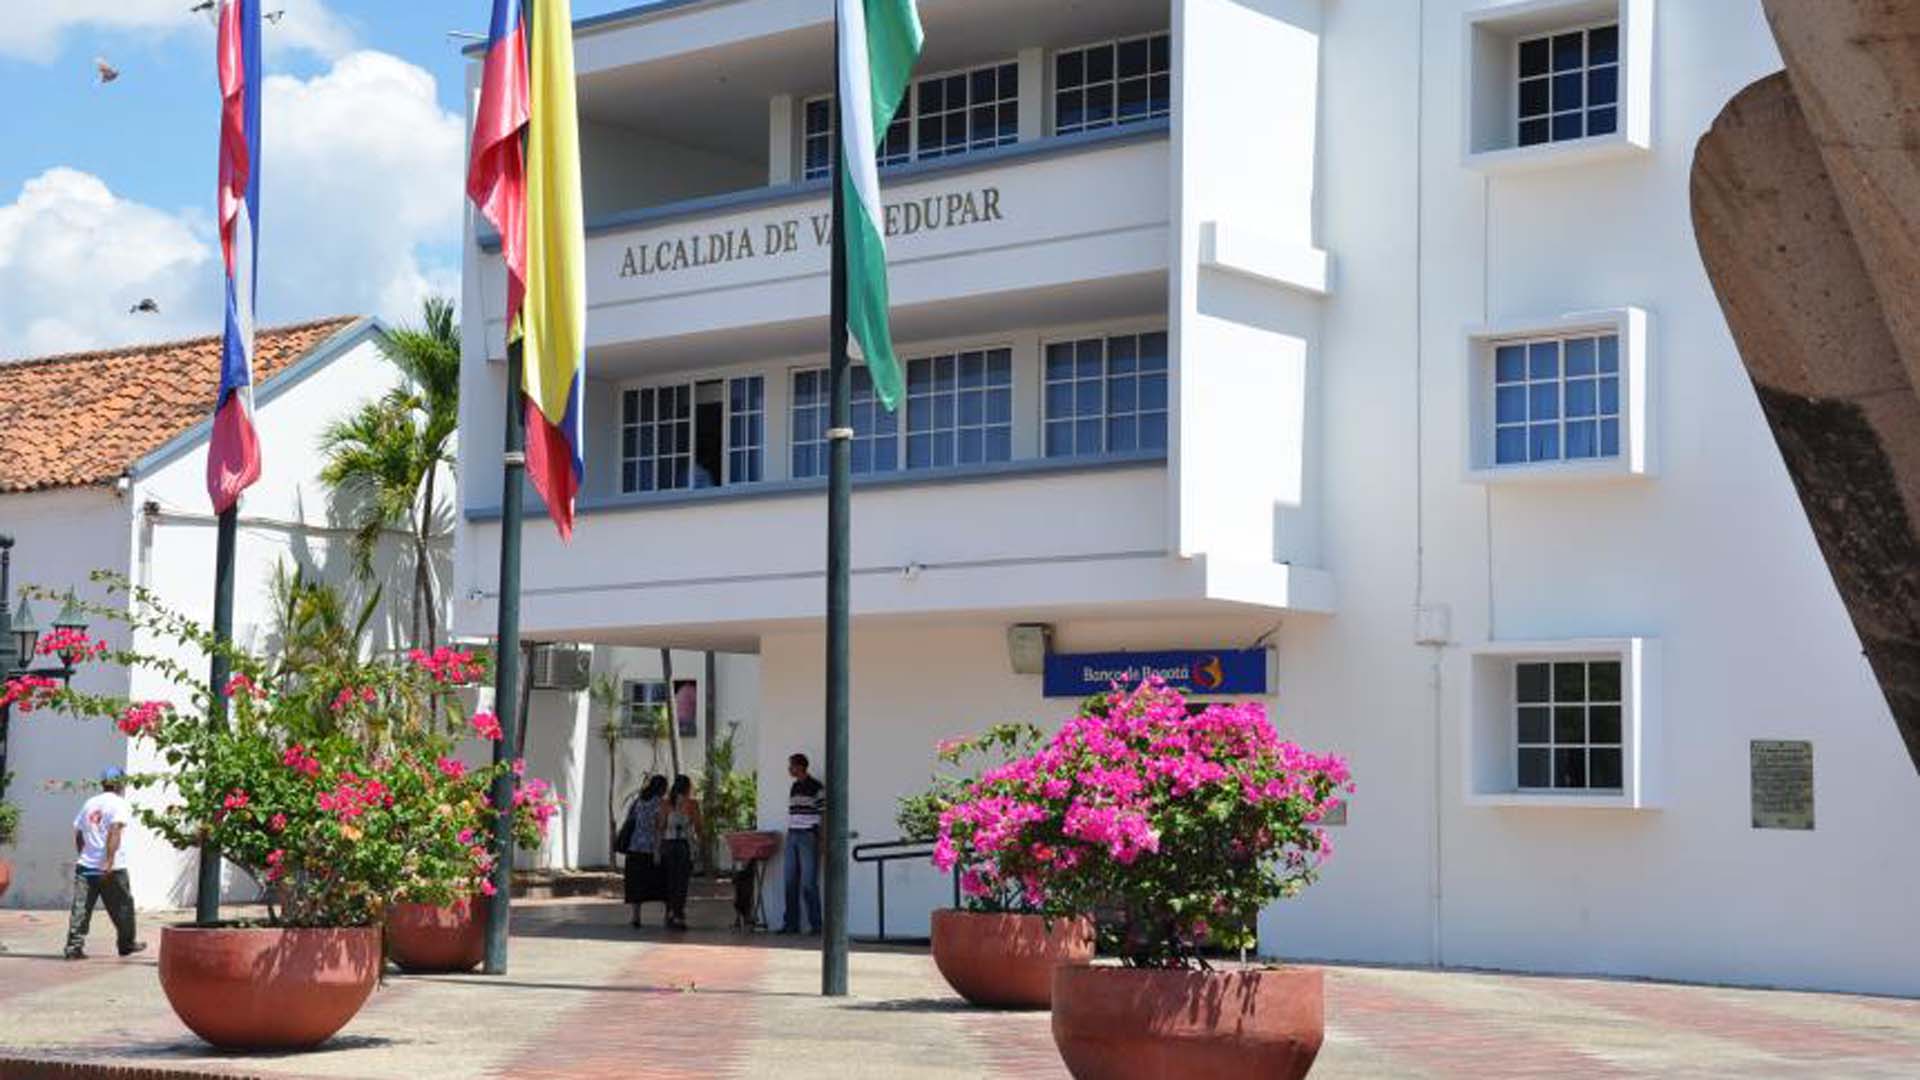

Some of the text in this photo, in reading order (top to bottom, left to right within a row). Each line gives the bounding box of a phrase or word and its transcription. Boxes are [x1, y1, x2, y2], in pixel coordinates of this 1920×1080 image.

[620, 188, 1002, 277] ALCALDIA DE VEDUPAR
[1083, 666, 1122, 682] Banco
